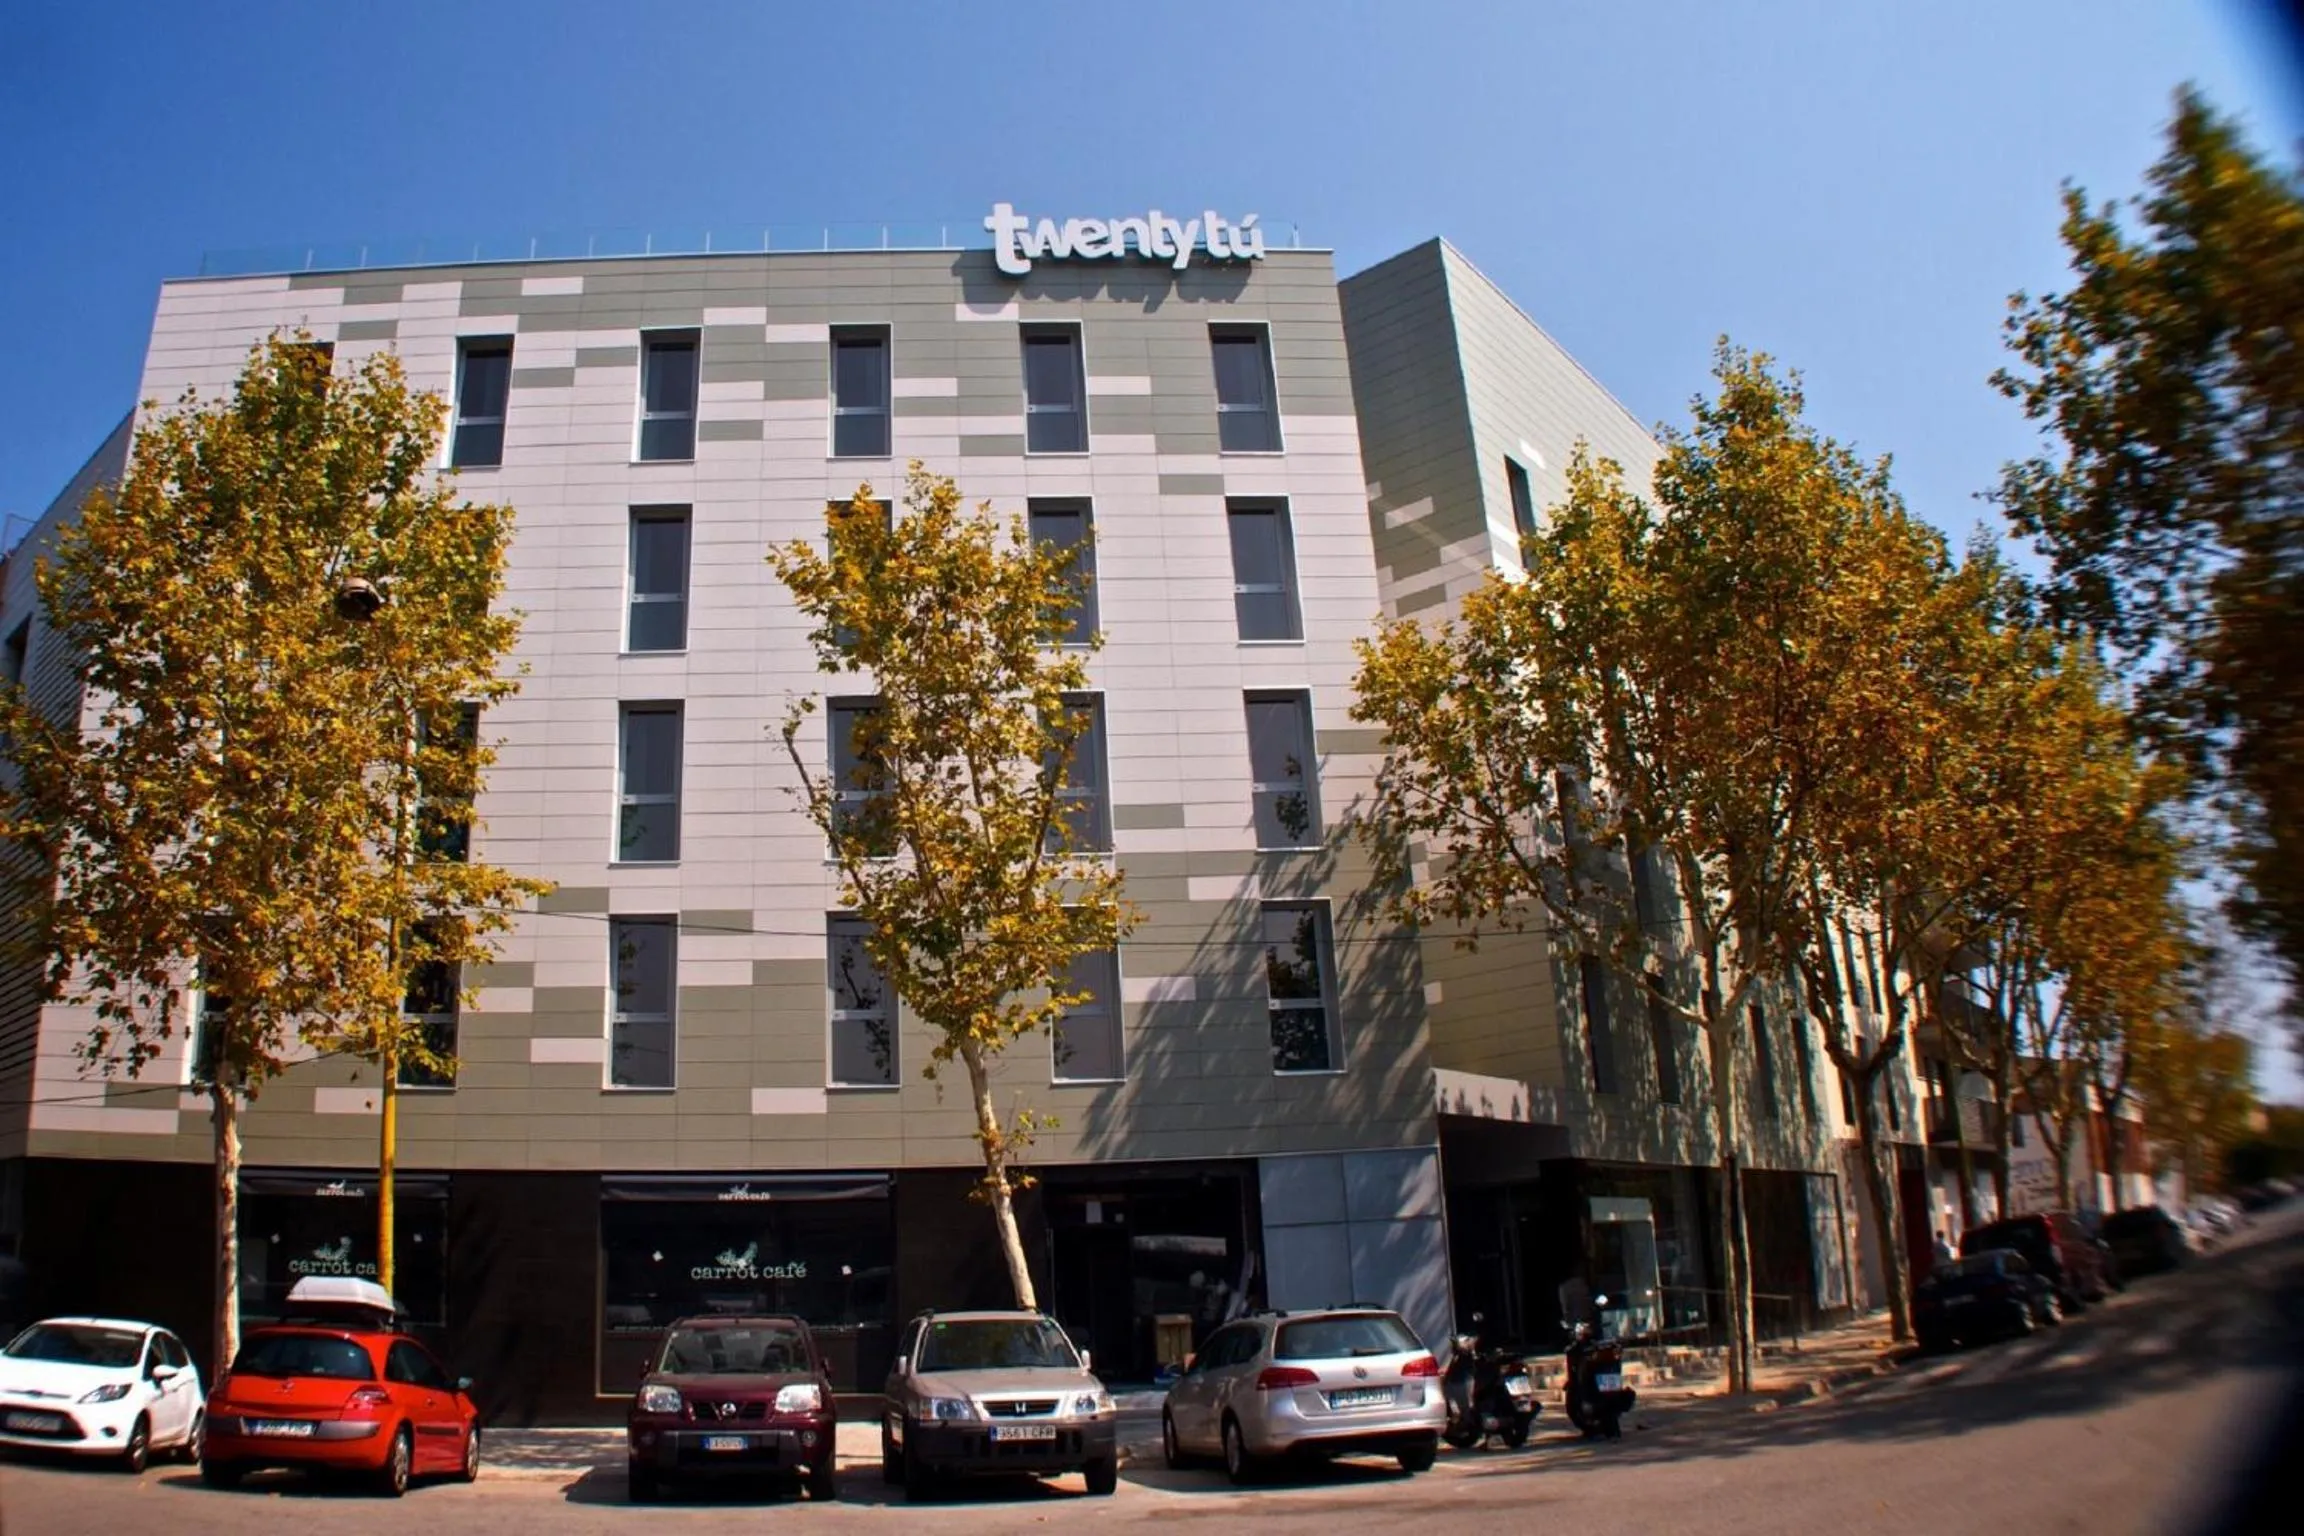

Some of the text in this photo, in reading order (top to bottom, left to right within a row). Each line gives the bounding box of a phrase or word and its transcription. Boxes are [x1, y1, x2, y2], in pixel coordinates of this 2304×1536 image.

[288, 1260, 352, 1275] carrot
[691, 1262, 807, 1279] carrot café
